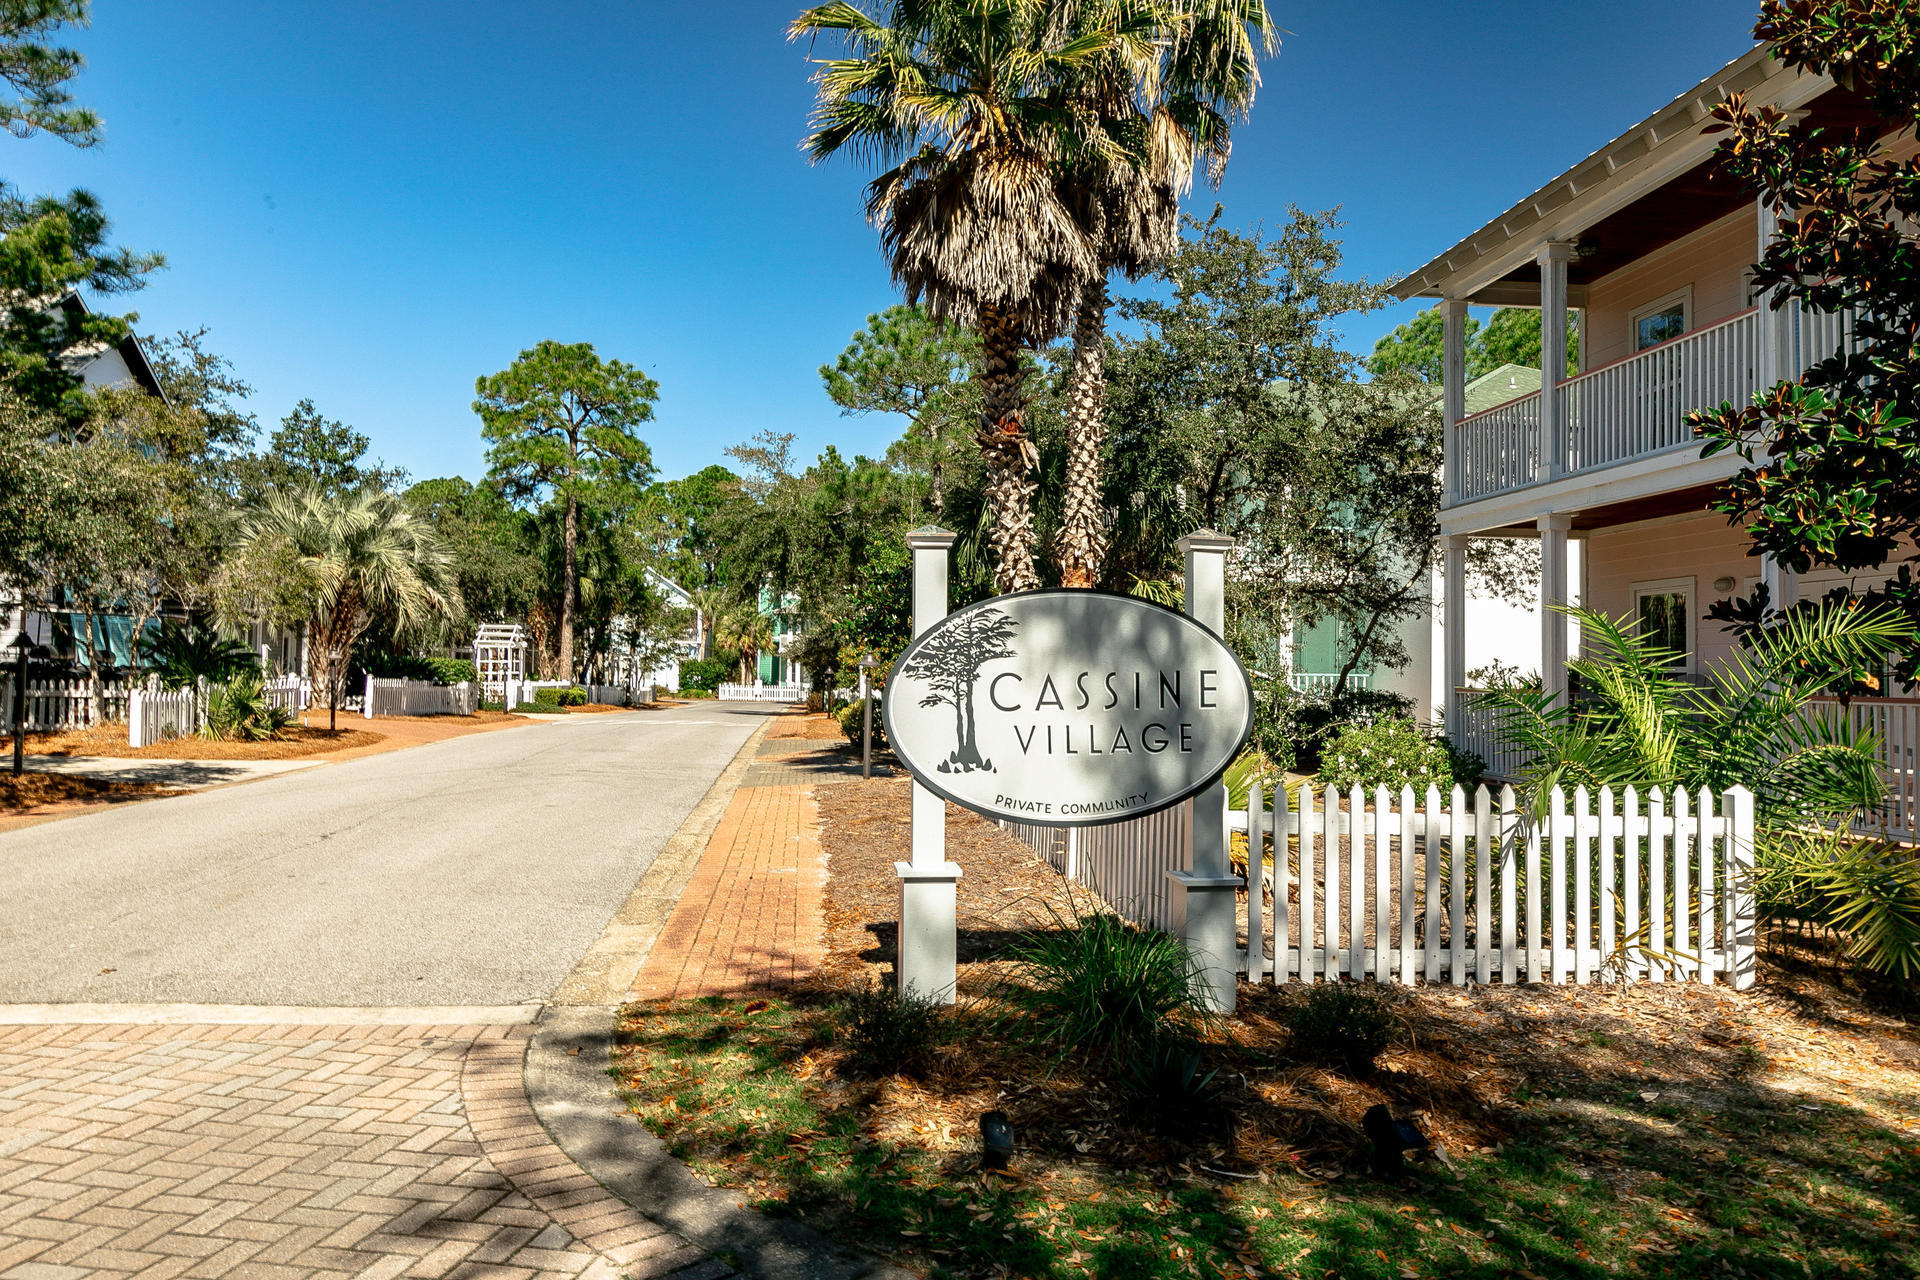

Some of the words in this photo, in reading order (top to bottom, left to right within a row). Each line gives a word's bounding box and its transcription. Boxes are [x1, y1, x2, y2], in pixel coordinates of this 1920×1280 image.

[989, 669, 1218, 712] CASSINE
[1013, 723, 1193, 755] VILLAGE
[994, 794, 1052, 814] PRIVATE
[1060, 792, 1149, 815] COMMUNITY
